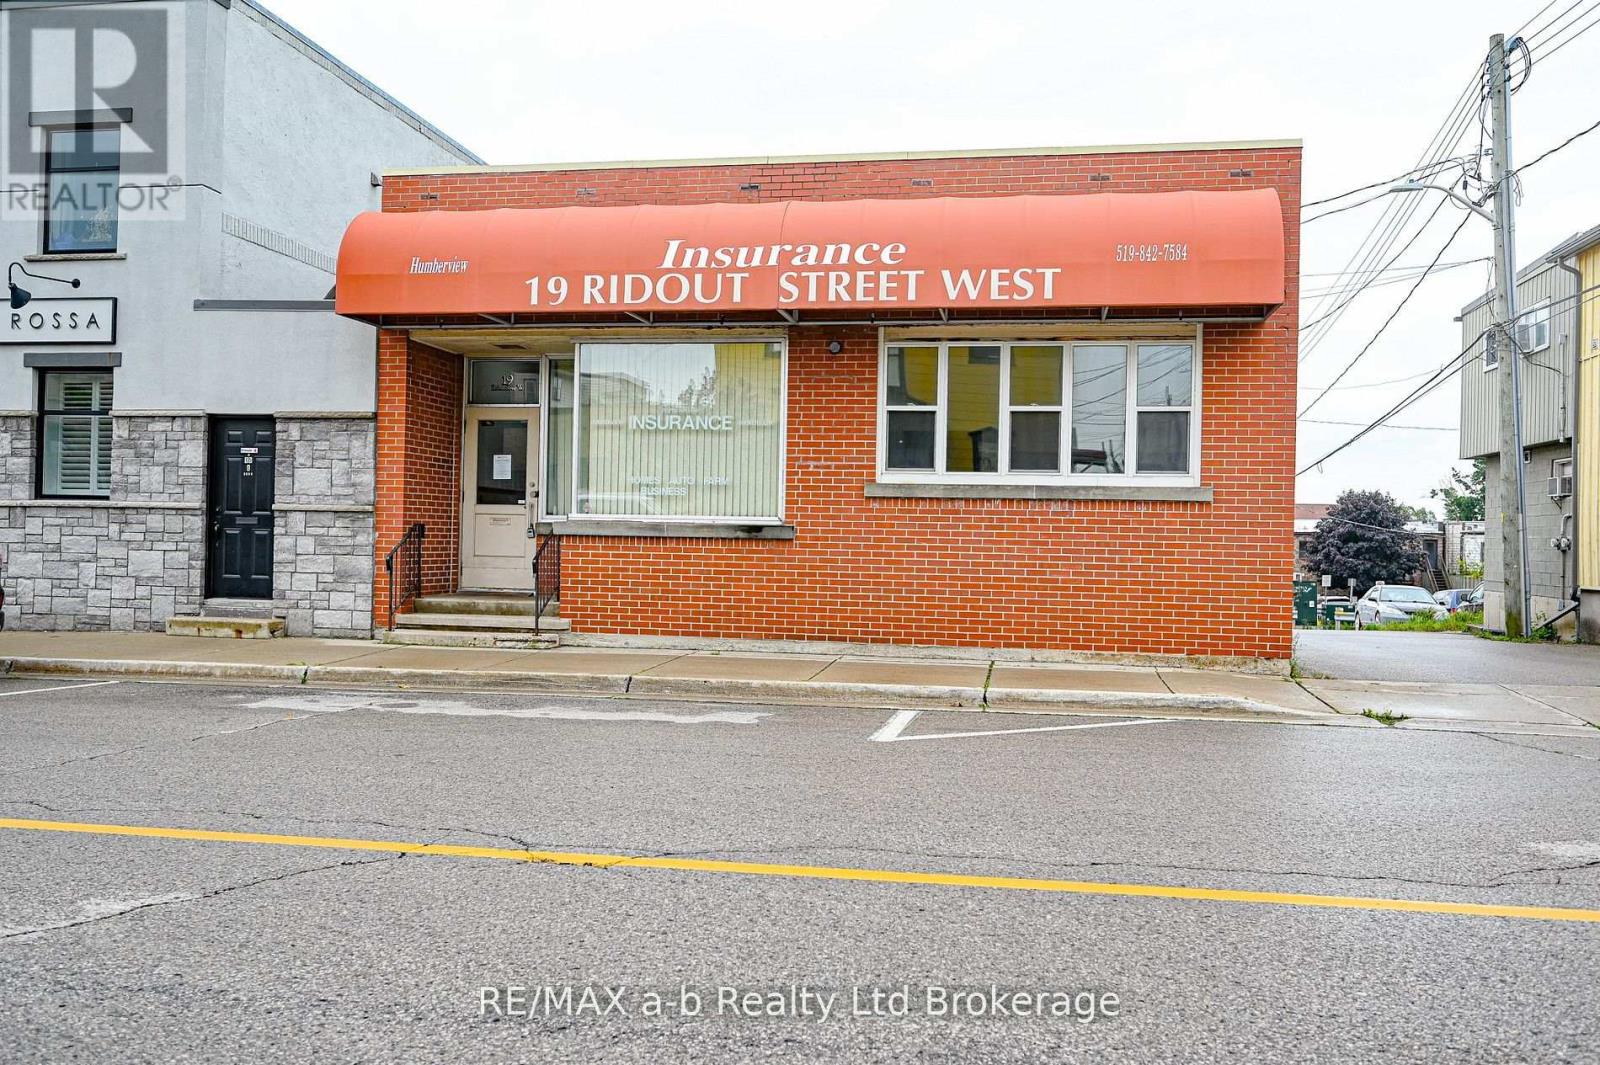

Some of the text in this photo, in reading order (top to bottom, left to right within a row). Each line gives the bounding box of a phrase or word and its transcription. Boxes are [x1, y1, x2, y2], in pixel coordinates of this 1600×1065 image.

[656, 239, 907, 270] Insurance
[1116, 243, 1188, 262] 519-842-7584
[409, 256, 469, 274] Humberview
[525, 268, 1062, 306] 19 RIDOUT STREET WEST
[10, 312, 101, 330] ROSSA
[628, 415, 734, 431] INSURANCE
